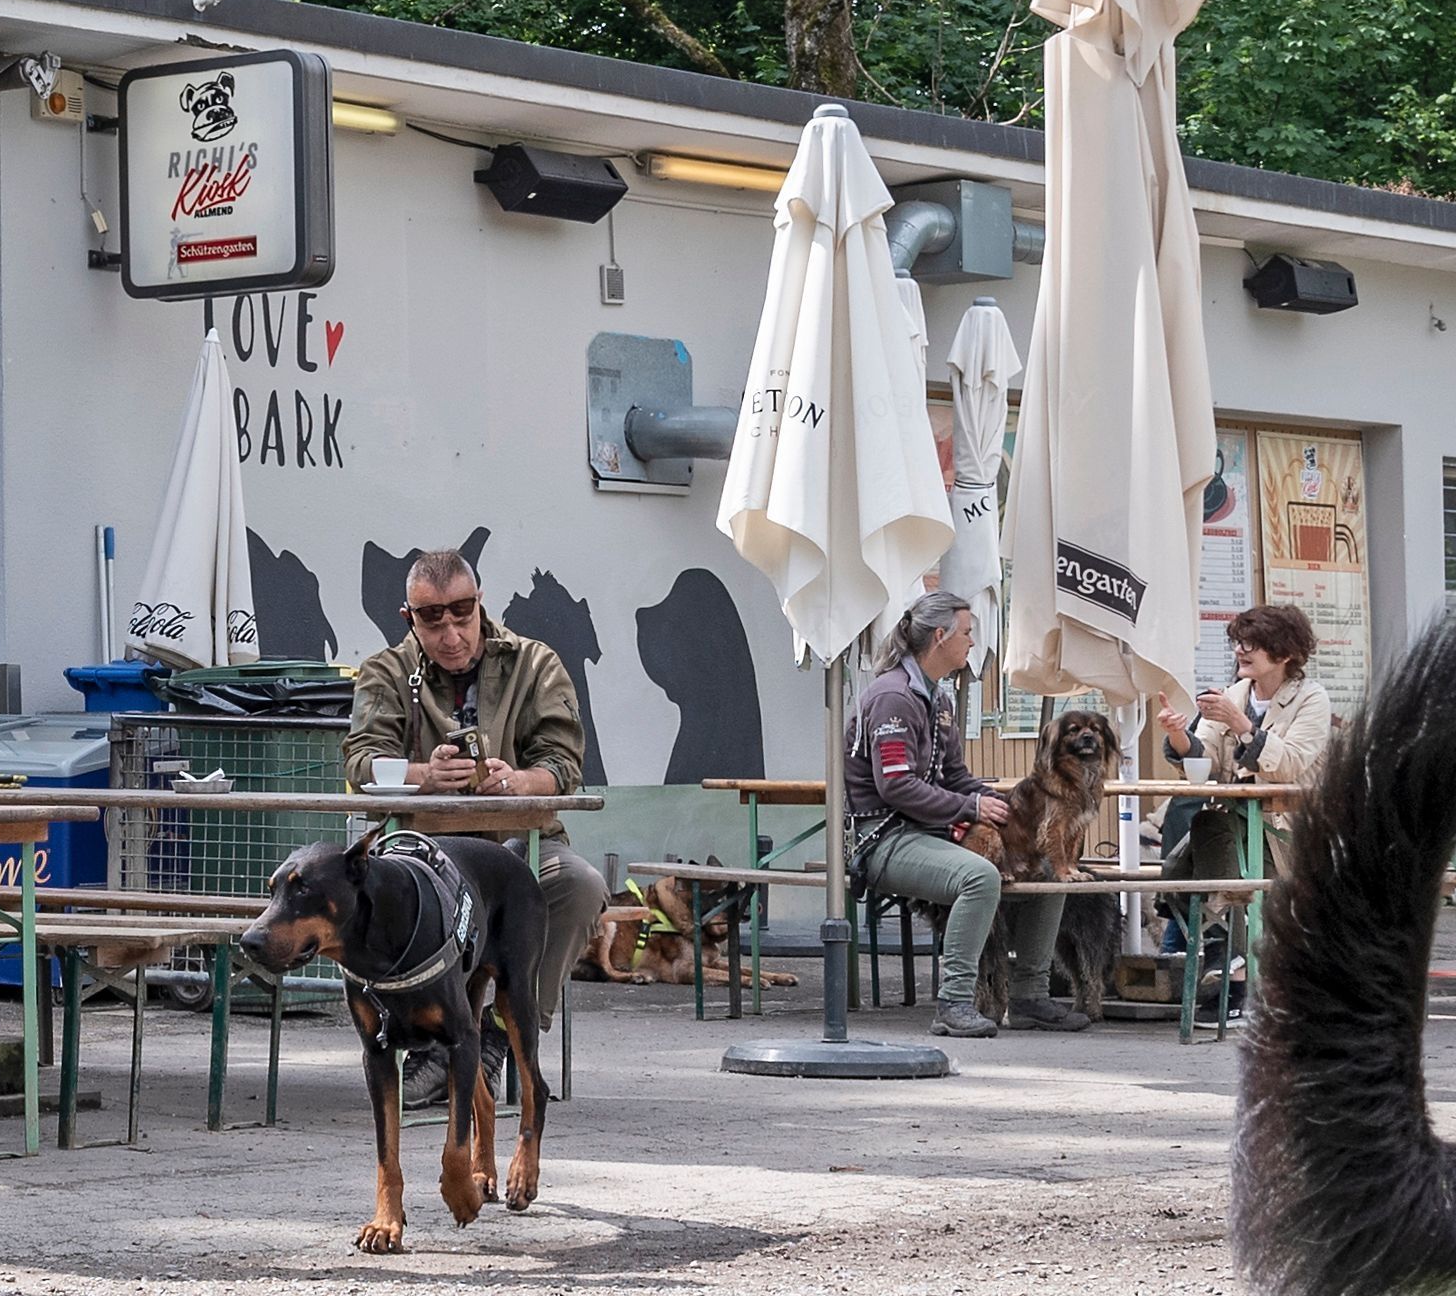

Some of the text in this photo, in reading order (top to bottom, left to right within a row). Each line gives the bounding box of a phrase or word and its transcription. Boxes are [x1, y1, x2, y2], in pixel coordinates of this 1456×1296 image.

[167, 142, 259, 179] RICHI'S
[171, 153, 252, 222] Kiosk
[194, 206, 234, 219] ALLMEND
[180, 242, 255, 258] Schützengarten
[235, 387, 344, 469] BARK
